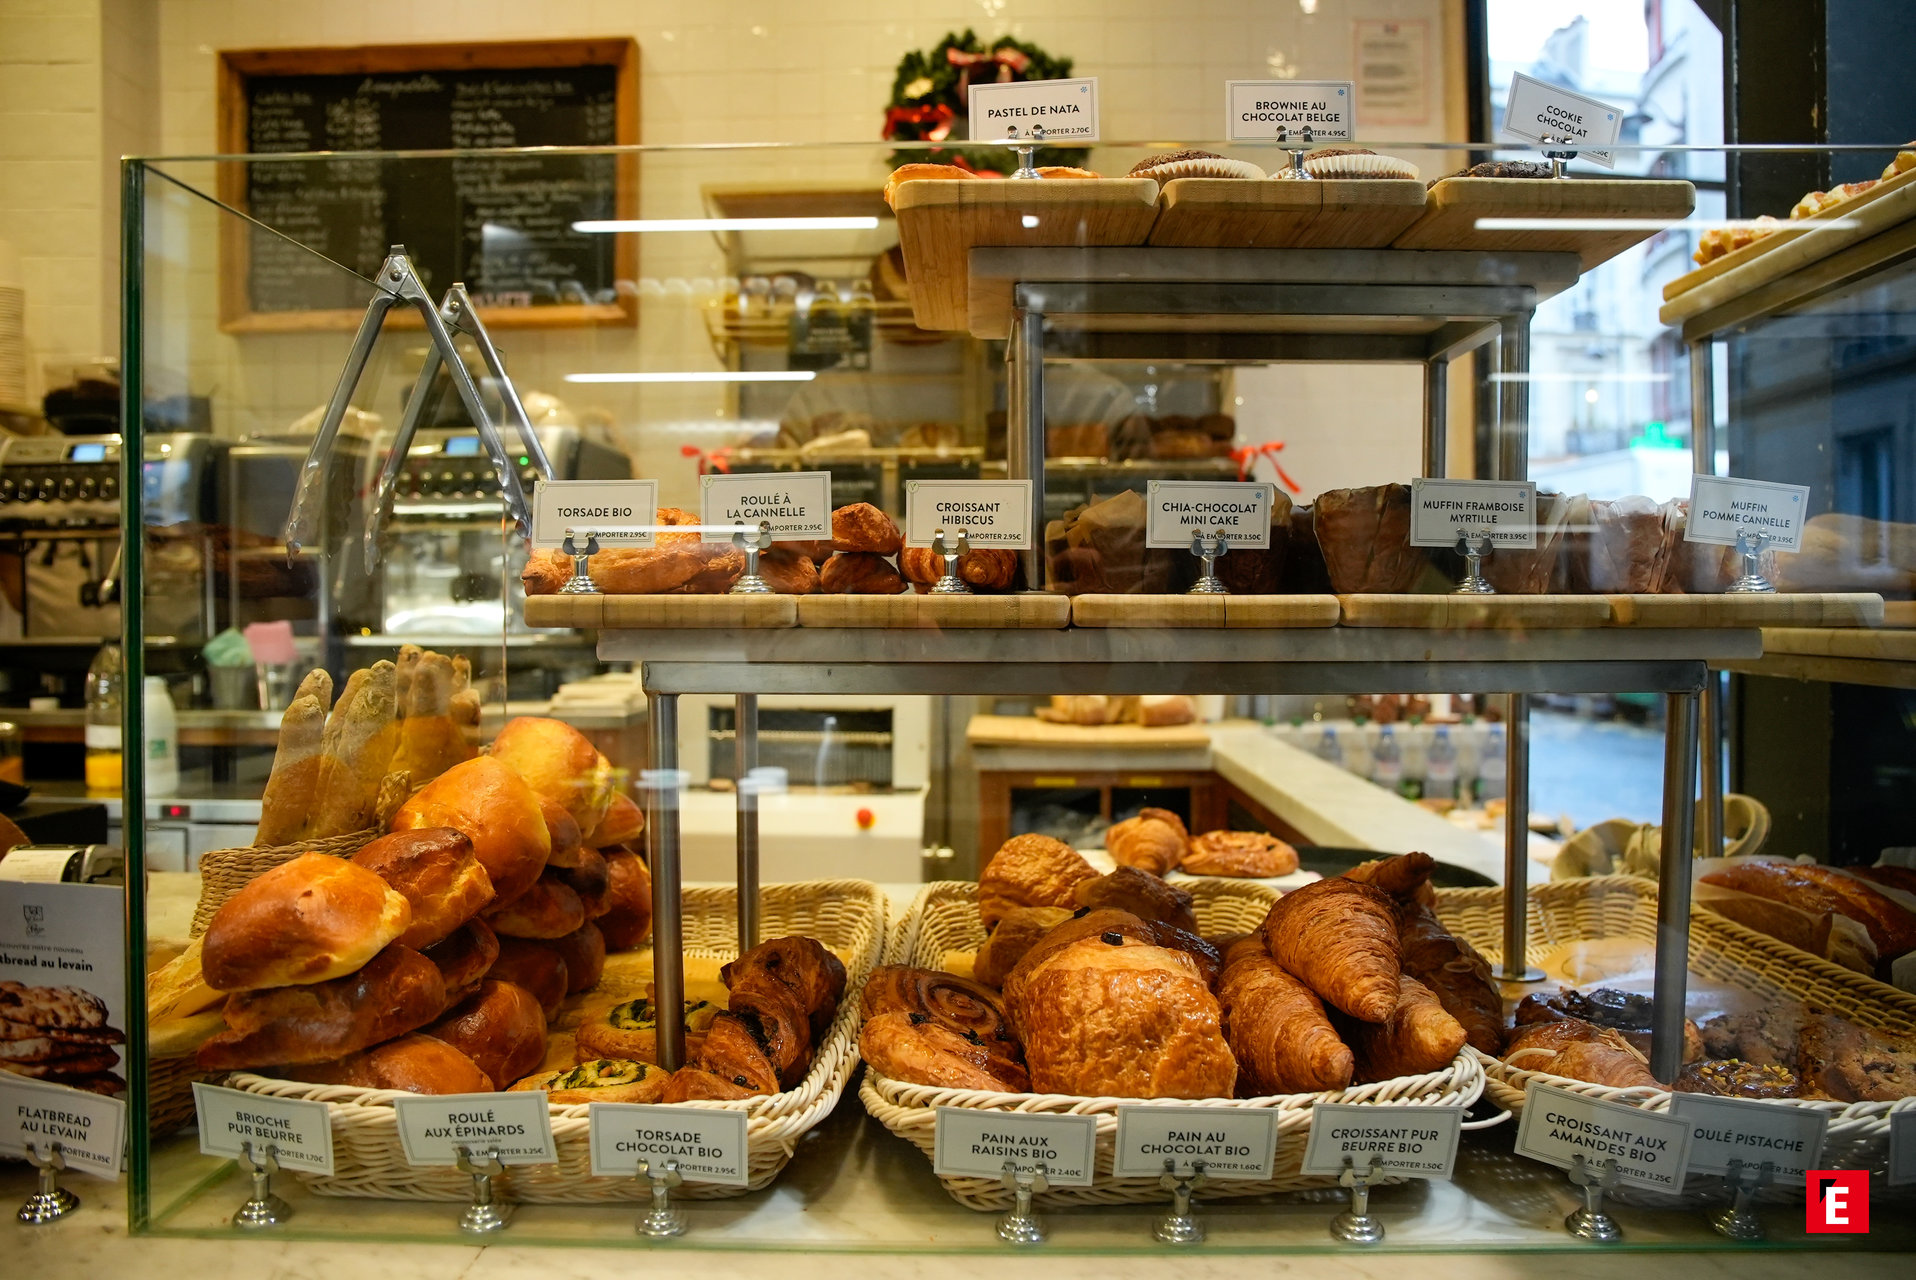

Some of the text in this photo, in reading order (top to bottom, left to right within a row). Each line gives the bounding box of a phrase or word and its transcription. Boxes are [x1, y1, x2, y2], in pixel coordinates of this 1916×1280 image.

[988, 104, 1080, 118] PASTEL DE NATA
[1256, 102, 1326, 110] BROWNIE AU
[1242, 112, 1340, 122] CHOCOLAT BELGE
[1546, 106, 1582, 124] COOKIE
[1537, 114, 1588, 138] CHOCOLAT
[741, 492, 792, 505] ROULÉ À
[558, 508, 632, 517] TORSADE BIO
[727, 507, 806, 518] LA CANNELLE
[936, 502, 1000, 512] CROISSANT
[1162, 502, 1258, 514] CHIA-CHOCOLAT
[1424, 500, 1524, 512] MUFFIN FRAMBOISE
[1731, 500, 1768, 513] MUFFIN
[942, 516, 994, 524] HIBISCUS
[1180, 516, 1239, 526] MINI CAKE
[1450, 514, 1498, 524] MYRTILLE
[1703, 510, 1790, 528] POMME CANNELLE
[41, 960, 54, 968] au
[58, 957, 93, 972] levain
[18, 1106, 91, 1128] FLATBREAD
[236, 1112, 291, 1129] BRIOCHE
[448, 1109, 495, 1124] ROULÉ
[20, 1120, 87, 1142] AU LEVAIN
[228, 1122, 303, 1144] PUR BEURRE
[425, 1124, 525, 1138] AUX ÉPINARDS
[636, 1130, 702, 1144] TORSADE
[1168, 1132, 1226, 1142] PAIN AU
[1331, 1128, 1438, 1140] CROISSANT PUR
[1546, 1112, 1668, 1151] CROISSANT AUX
[982, 1133, 1048, 1147] PAIN AUX
[1549, 1128, 1656, 1163] AMANDES BIO
[1694, 1128, 1804, 1152] OULÉ PISTACHE
[616, 1142, 722, 1158] CHOCOLAT BIO
[972, 1145, 1058, 1160] RAISINS BIO
[1141, 1144, 1250, 1156] CHOCOLAT BIO
[1342, 1142, 1422, 1154] BEURRE BIO
[306, 1154, 324, 1162] 1.70€
[1058, 1168, 1082, 1176] 2.40€
[1422, 1162, 1444, 1170] 1.50€
[1648, 1172, 1672, 1184] 3.25€
